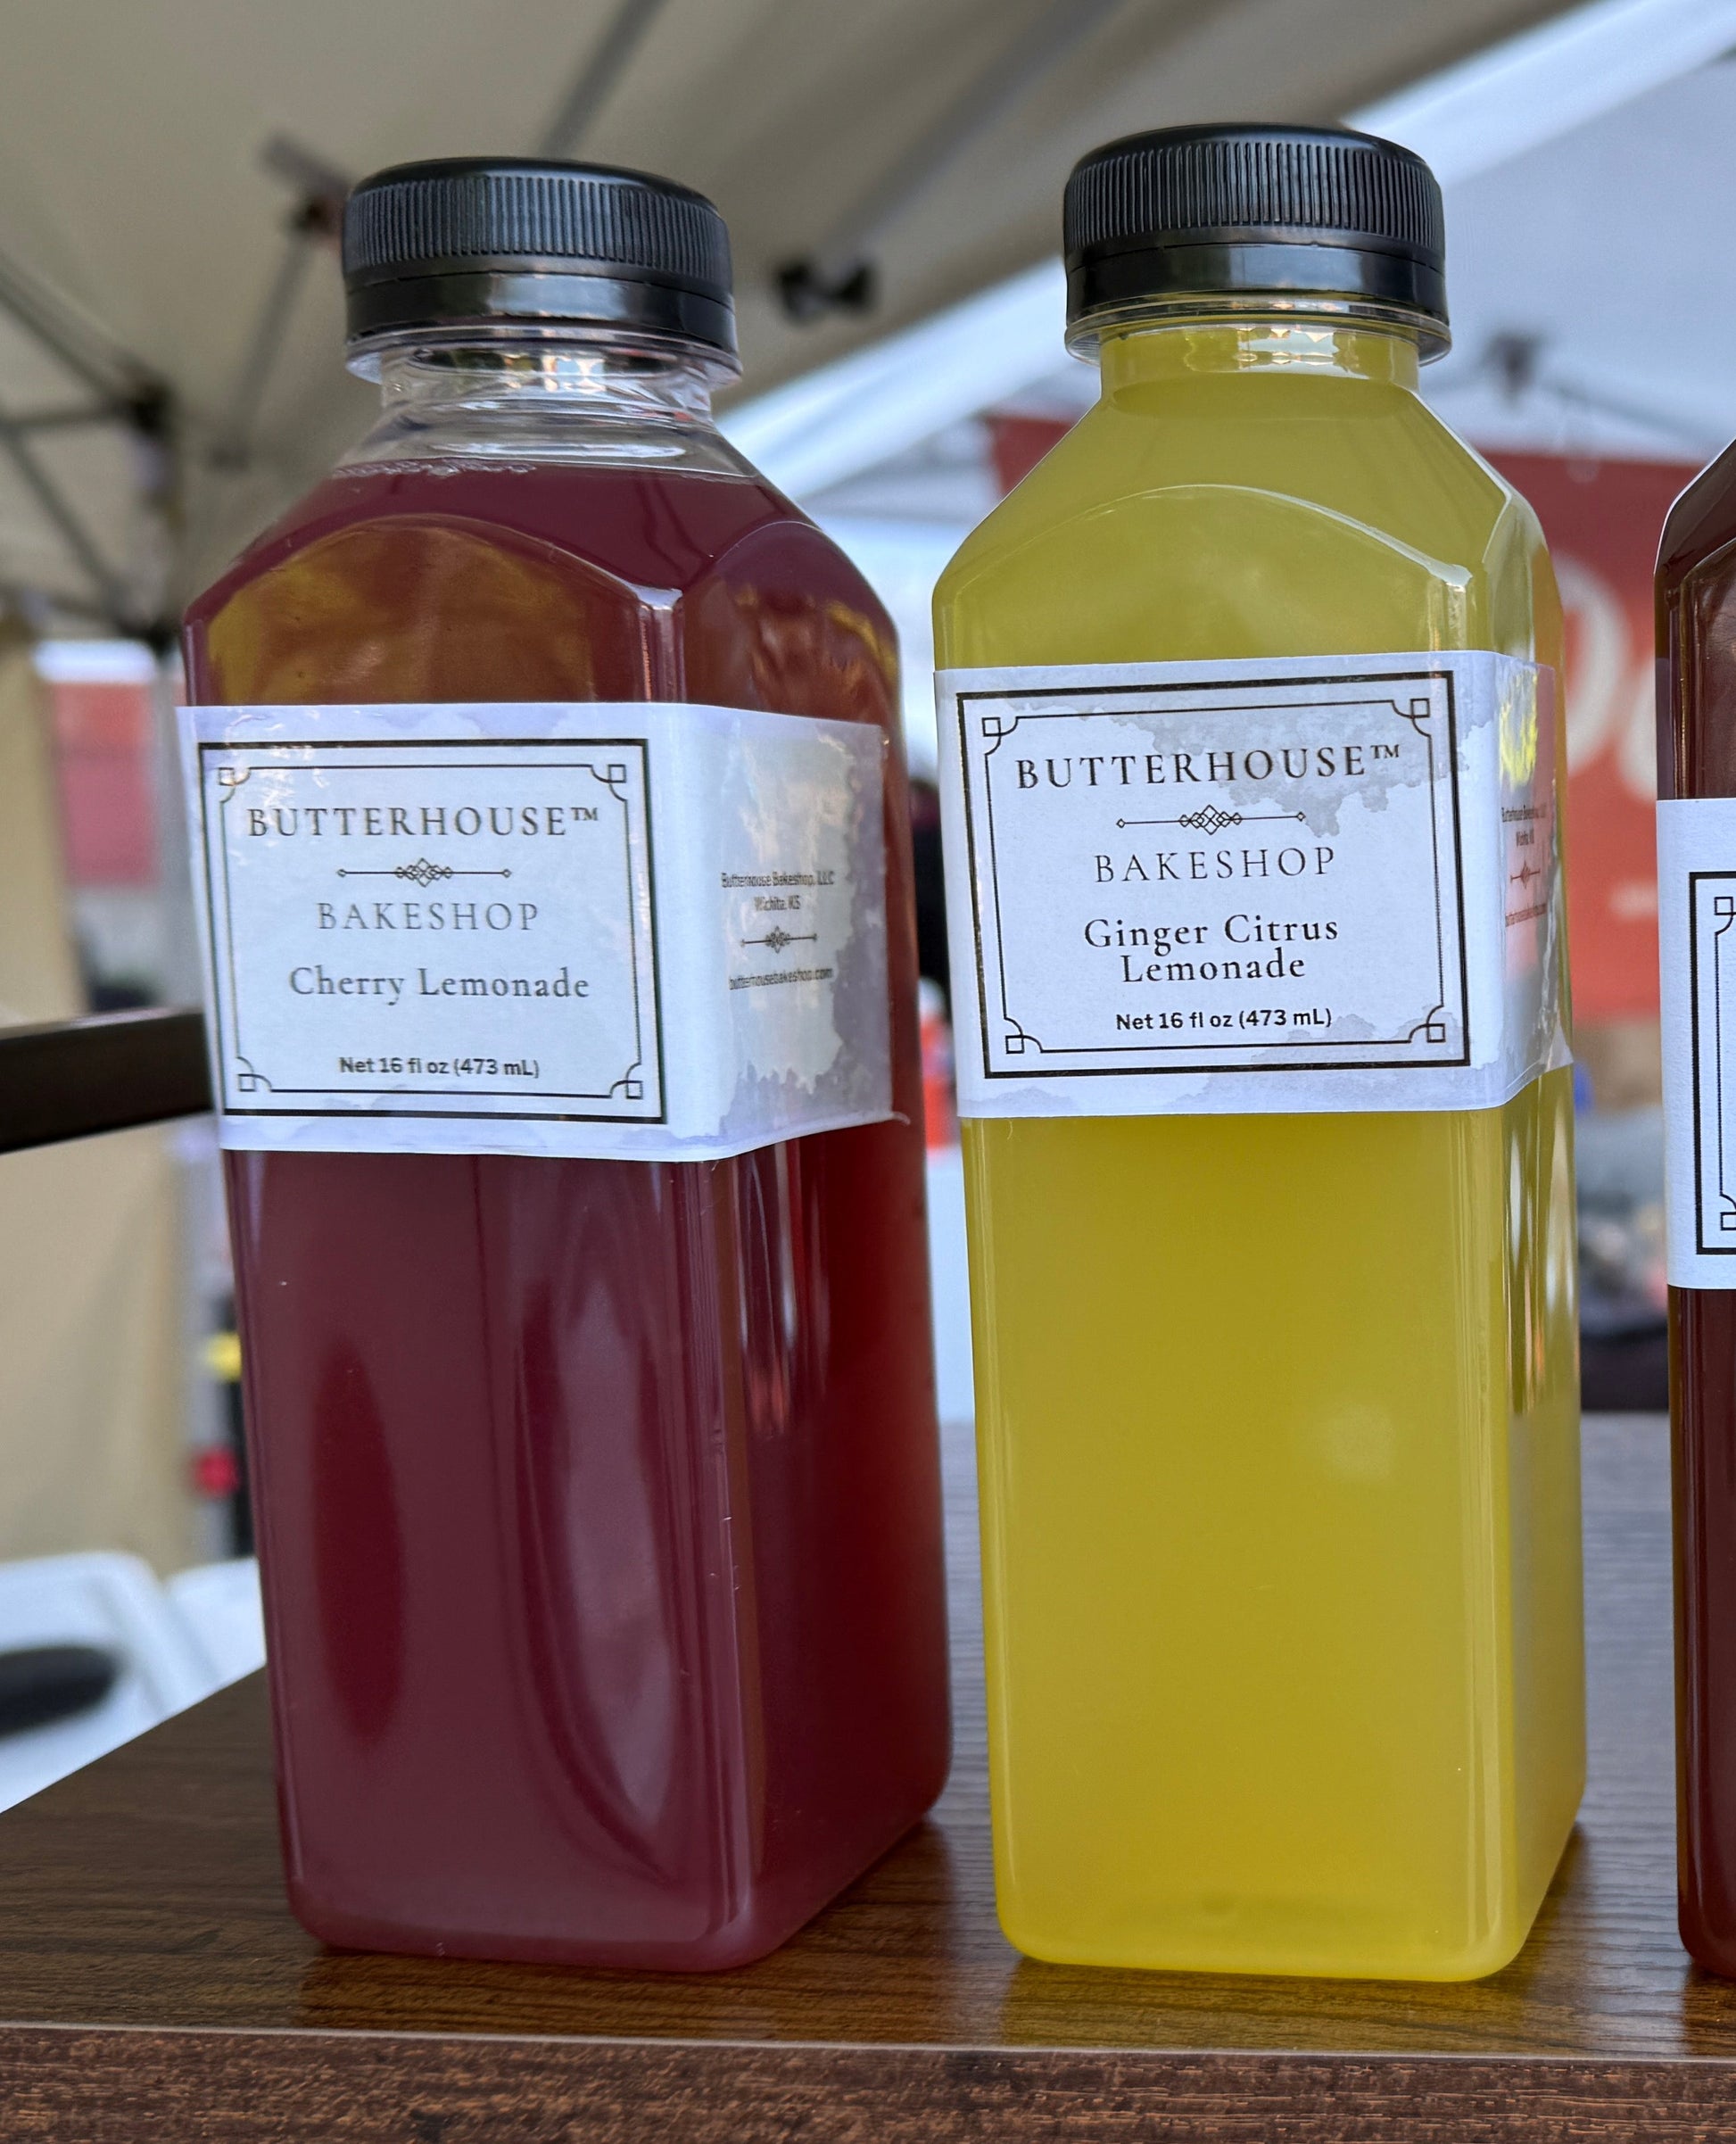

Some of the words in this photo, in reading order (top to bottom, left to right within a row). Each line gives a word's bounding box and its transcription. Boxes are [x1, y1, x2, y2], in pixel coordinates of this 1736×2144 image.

[1095, 847, 1335, 882] BAKESHOP
[317, 902, 538, 931] BAKESHOP
[1084, 918, 1209, 956] Ginger
[1224, 915, 1339, 944] Citrus
[1121, 948, 1306, 982] Lemonade
[289, 964, 405, 1006] Cherry
[417, 967, 590, 997] Lemonade
[1116, 1014, 1153, 1031] Net
[1159, 1012, 1184, 1029] 16
[1189, 1011, 1203, 1028] fl
[1209, 1015, 1233, 1028] oz
[1238, 1009, 1286, 1029] (473
[1294, 1007, 1332, 1028] mL)
[339, 1056, 374, 1073] Net
[379, 1057, 404, 1073] 16
[408, 1057, 422, 1073] fl
[426, 1063, 450, 1074] oz
[453, 1058, 498, 1077] (473
[504, 1059, 540, 1079] mL)
